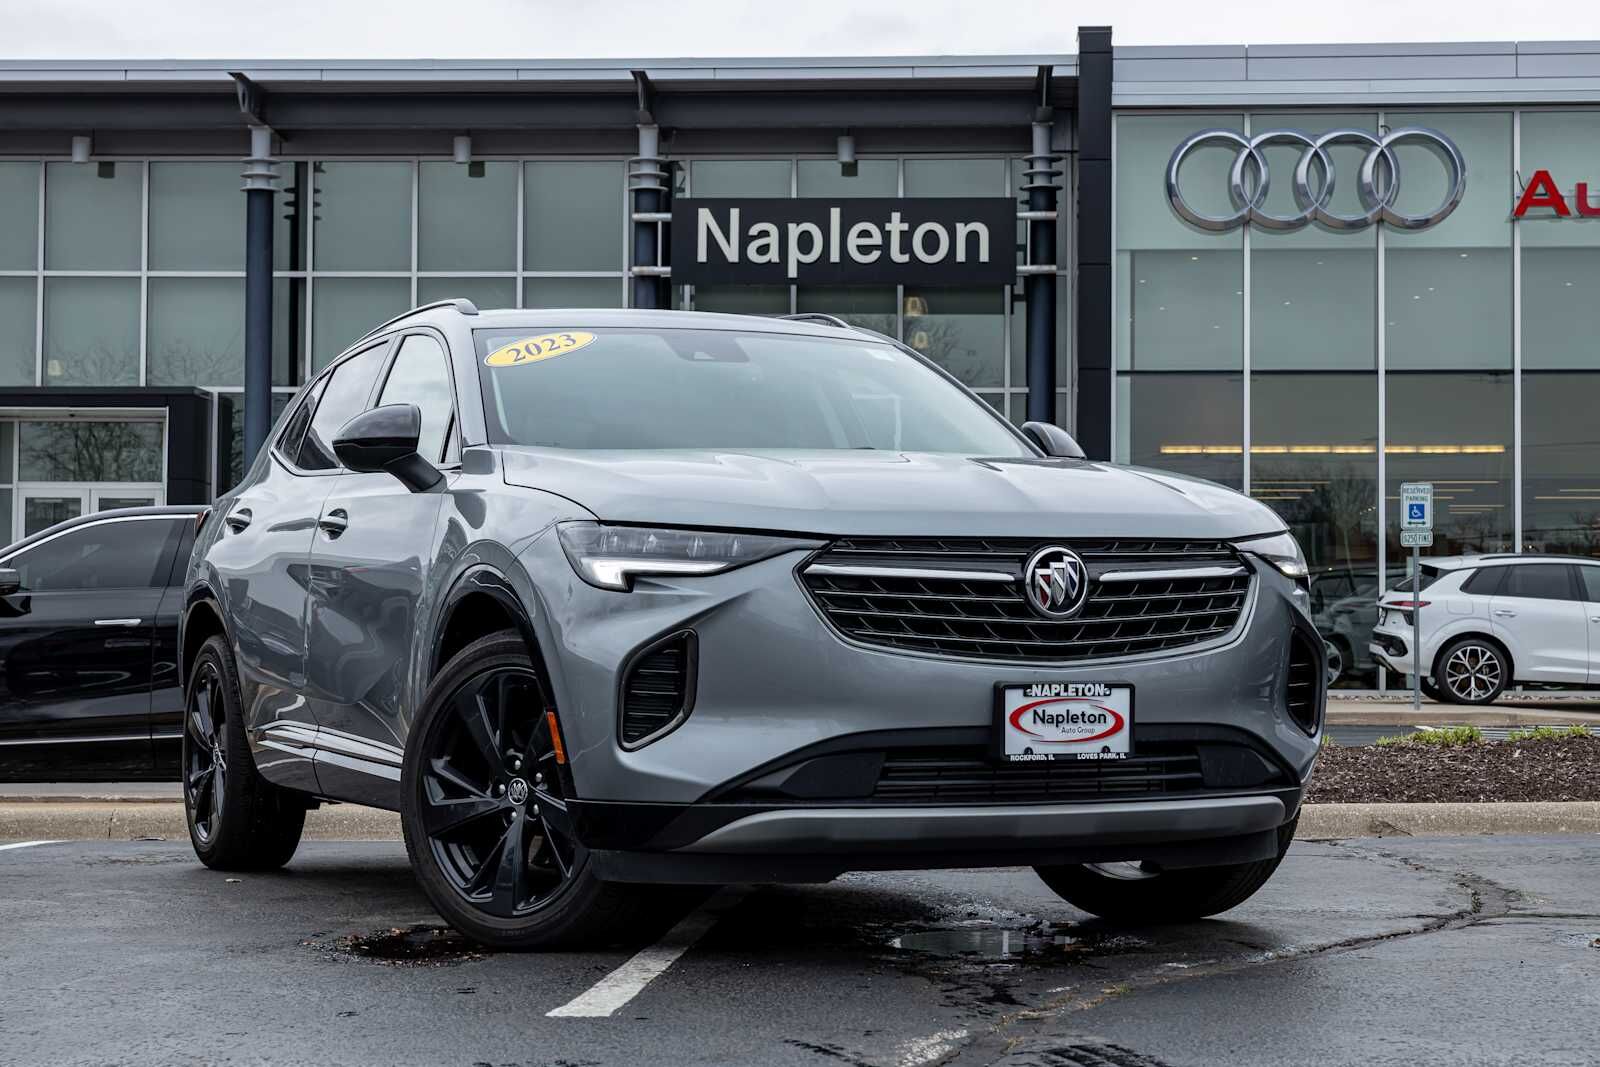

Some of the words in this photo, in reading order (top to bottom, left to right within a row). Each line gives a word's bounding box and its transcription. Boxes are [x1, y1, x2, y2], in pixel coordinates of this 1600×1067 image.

[697, 207, 990, 279] Napleton
[506, 334, 577, 362] 2023
[1031, 684, 1105, 697] NAPLETON
[1032, 709, 1107, 728] Napleton
[1077, 727, 1096, 736] Group
